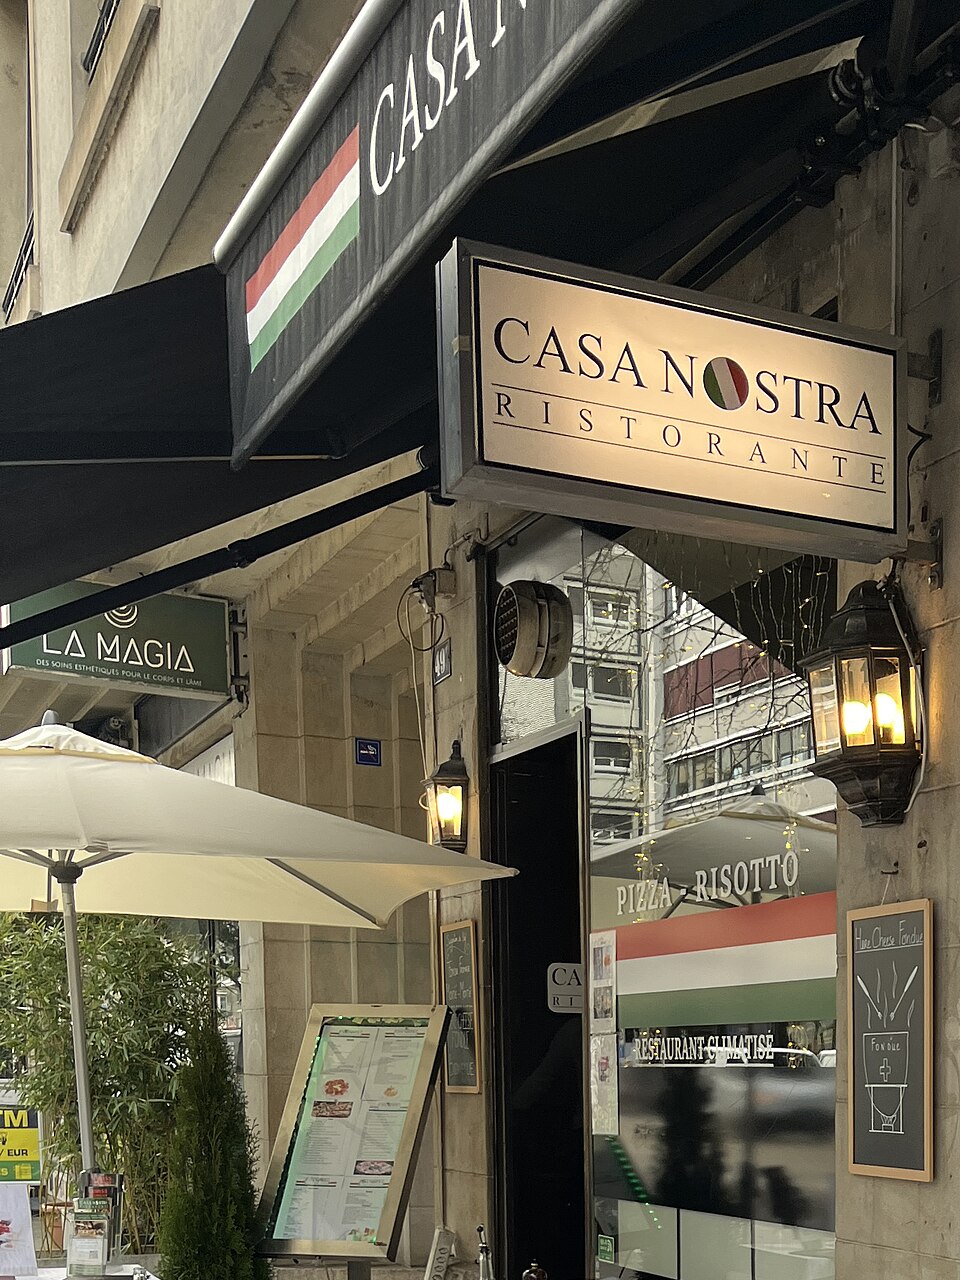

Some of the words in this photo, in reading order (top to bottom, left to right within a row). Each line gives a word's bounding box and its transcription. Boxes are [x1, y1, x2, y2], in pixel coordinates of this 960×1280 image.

[370, 0, 480, 195] CASA
[493, 317, 648, 389] CASA
[658, 349, 883, 435] NOSTRA
[495, 392, 885, 485] RISTORANTE
[36, 658, 50, 667] DES
[51, 660, 73, 670] SOINS
[121, 670, 142, 680] POUR
[152, 674, 176, 684] CORPS
[41, 629, 86, 658] LA
[97, 632, 195, 673] MAGIA
[616, 876, 673, 916] PIZZA
[695, 850, 799, 902] RISOTTO
[635, 1036, 705, 1061] RESTAURANT
[8, 1149, 29, 1157] EUR
